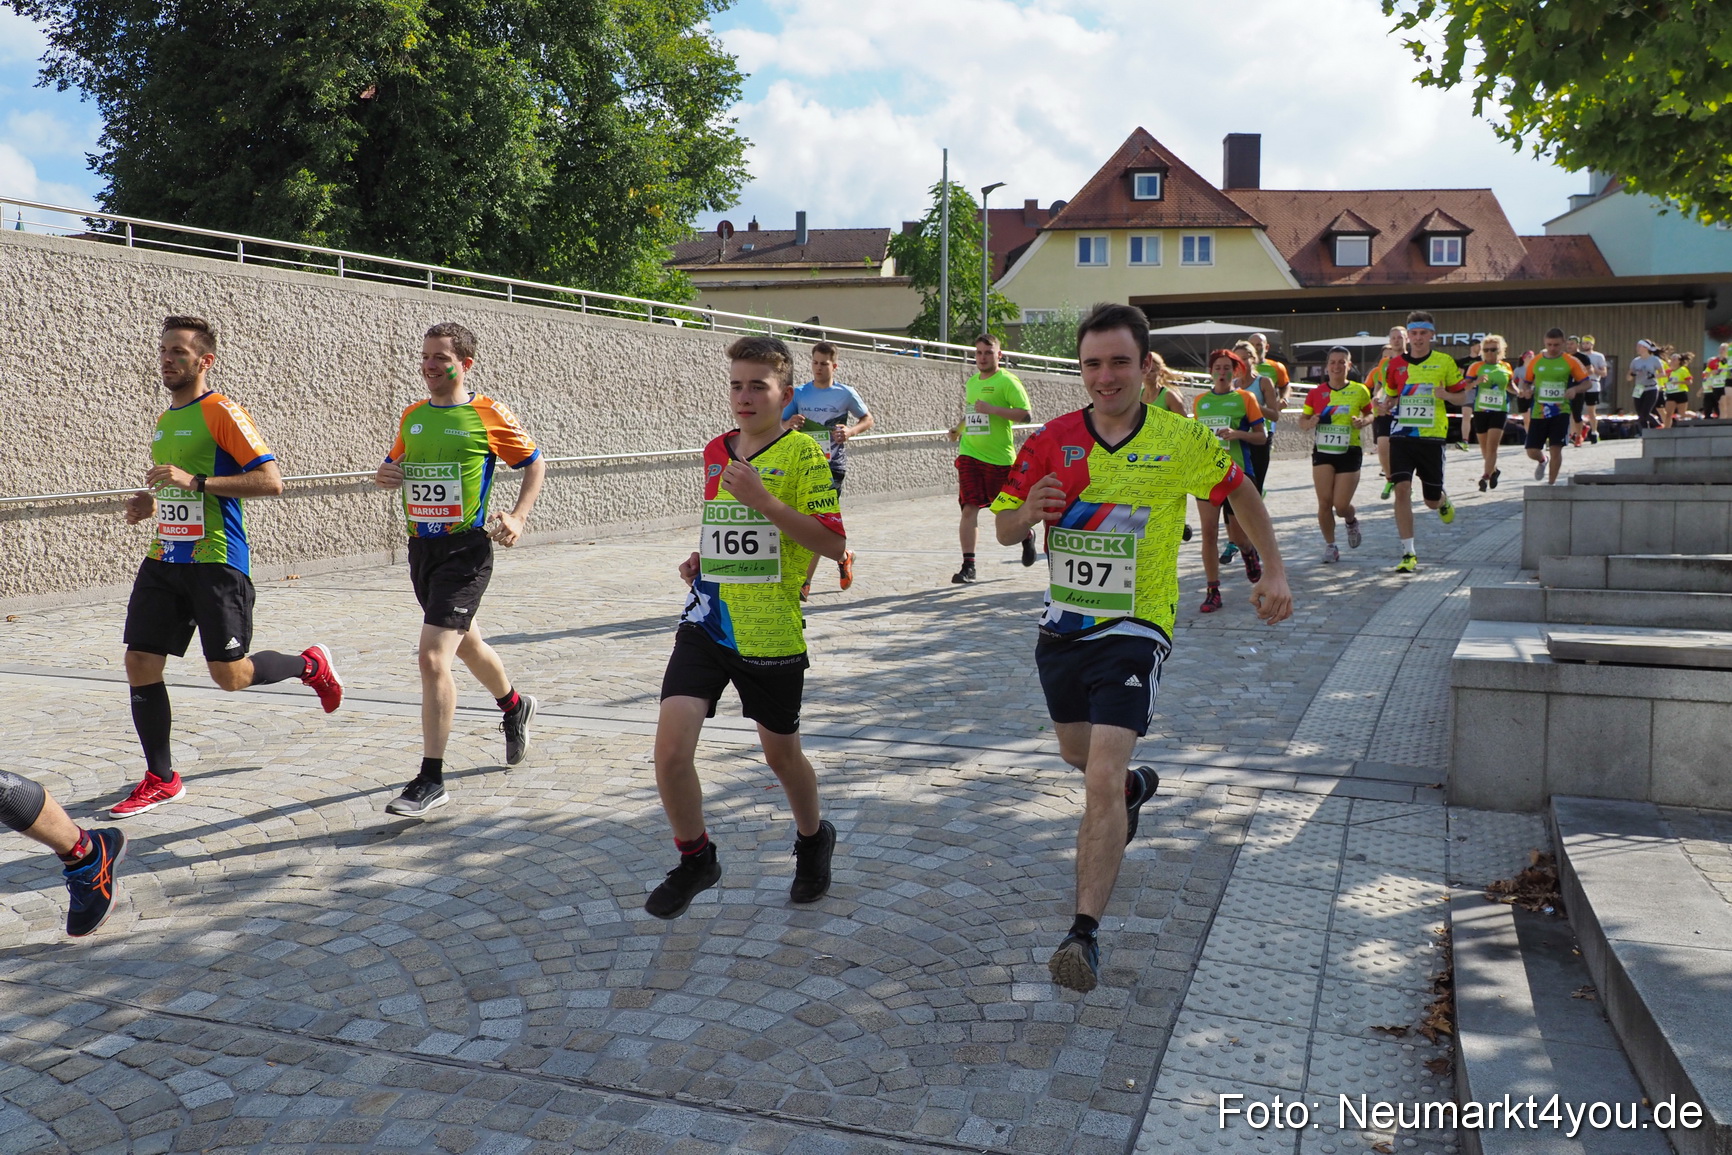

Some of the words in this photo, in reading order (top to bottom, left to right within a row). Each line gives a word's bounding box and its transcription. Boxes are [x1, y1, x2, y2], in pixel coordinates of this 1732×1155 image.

[1544, 389, 1560, 397] 190
[1406, 407, 1427, 417] 172
[968, 415, 982, 424] 144
[1324, 434, 1342, 444] 171
[405, 465, 454, 478] BOCK
[411, 484, 446, 502] 529
[807, 497, 835, 510] BMW
[161, 504, 189, 521] 530
[412, 507, 450, 516] MARKUS
[706, 505, 767, 522] BOCK
[162, 526, 188, 534] MARCO
[712, 530, 759, 555] 166
[1053, 532, 1127, 556] BOCK
[1065, 559, 1112, 588] 197
